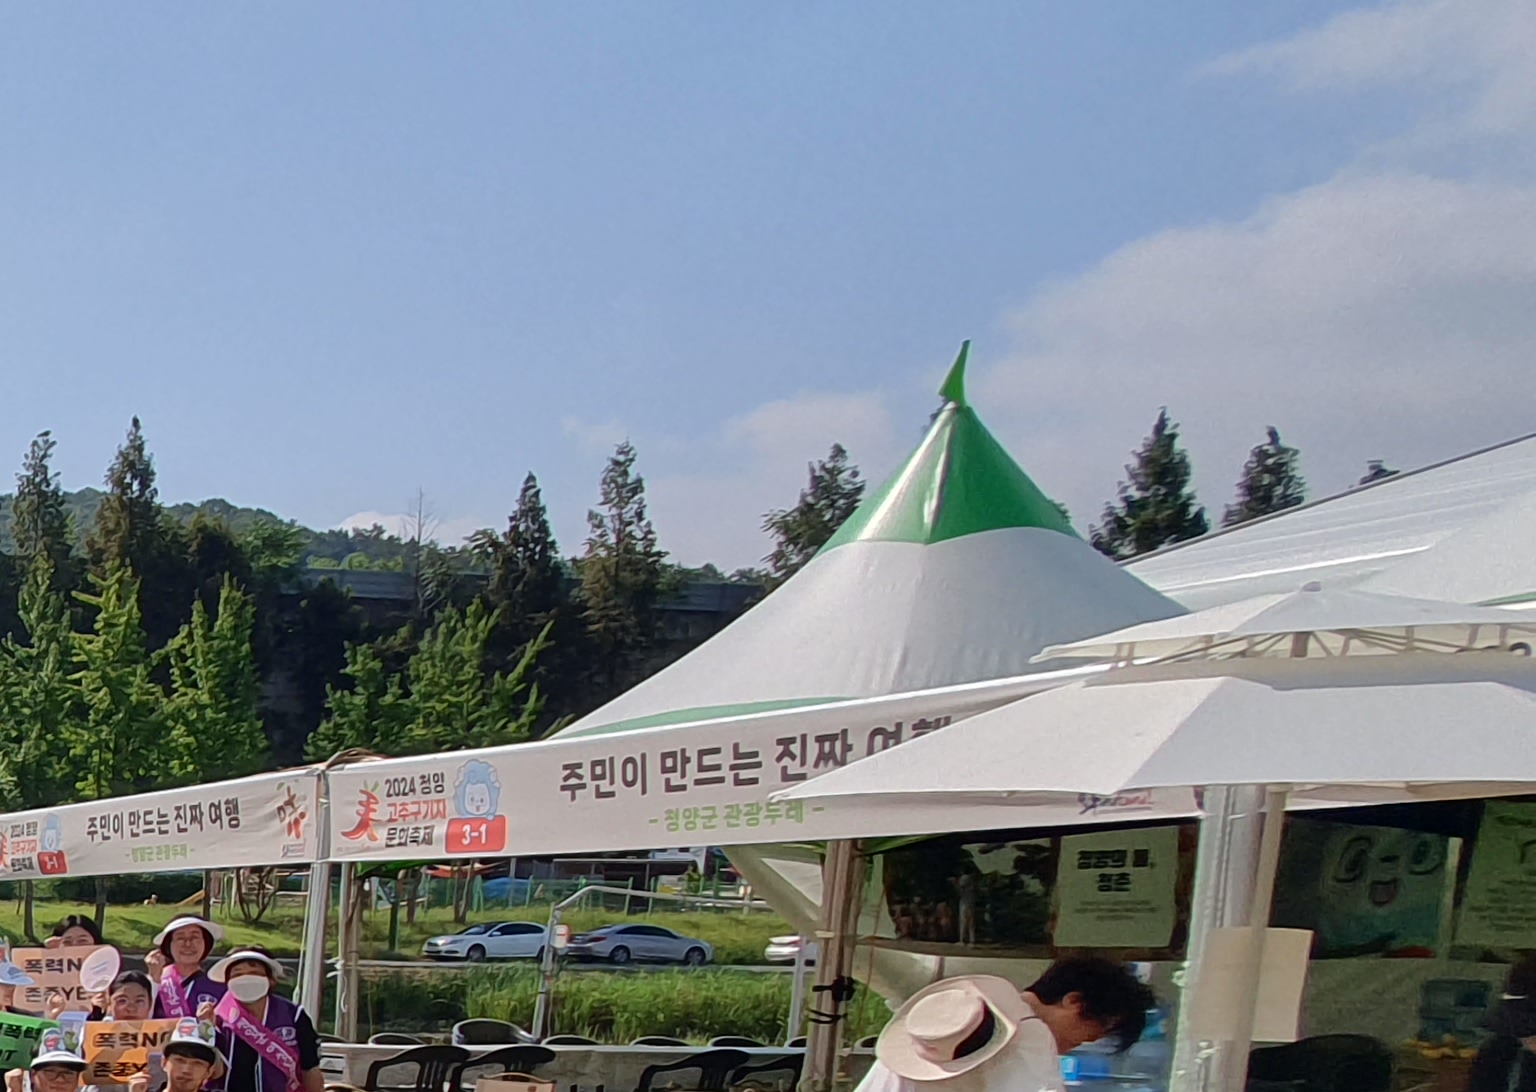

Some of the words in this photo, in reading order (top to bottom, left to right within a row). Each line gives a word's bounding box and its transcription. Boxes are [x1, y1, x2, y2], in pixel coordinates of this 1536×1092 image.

[559, 752, 648, 802] 주민이
[659, 742, 763, 794] 만드는
[774, 727, 853, 782] 진짜
[384, 776, 417, 798] 2024
[419, 771, 446, 795] 청양
[86, 810, 124, 842] 주민이
[128, 807, 171, 838] 만드는
[174, 801, 205, 834] 진짜
[208, 797, 241, 830] 여행
[386, 798, 448, 823] 고추구기자
[664, 805, 719, 832] 청양군
[384, 824, 436, 849] 문화축제
[461, 823, 488, 846] 3-1
[24, 957, 81, 975] 폭력N
